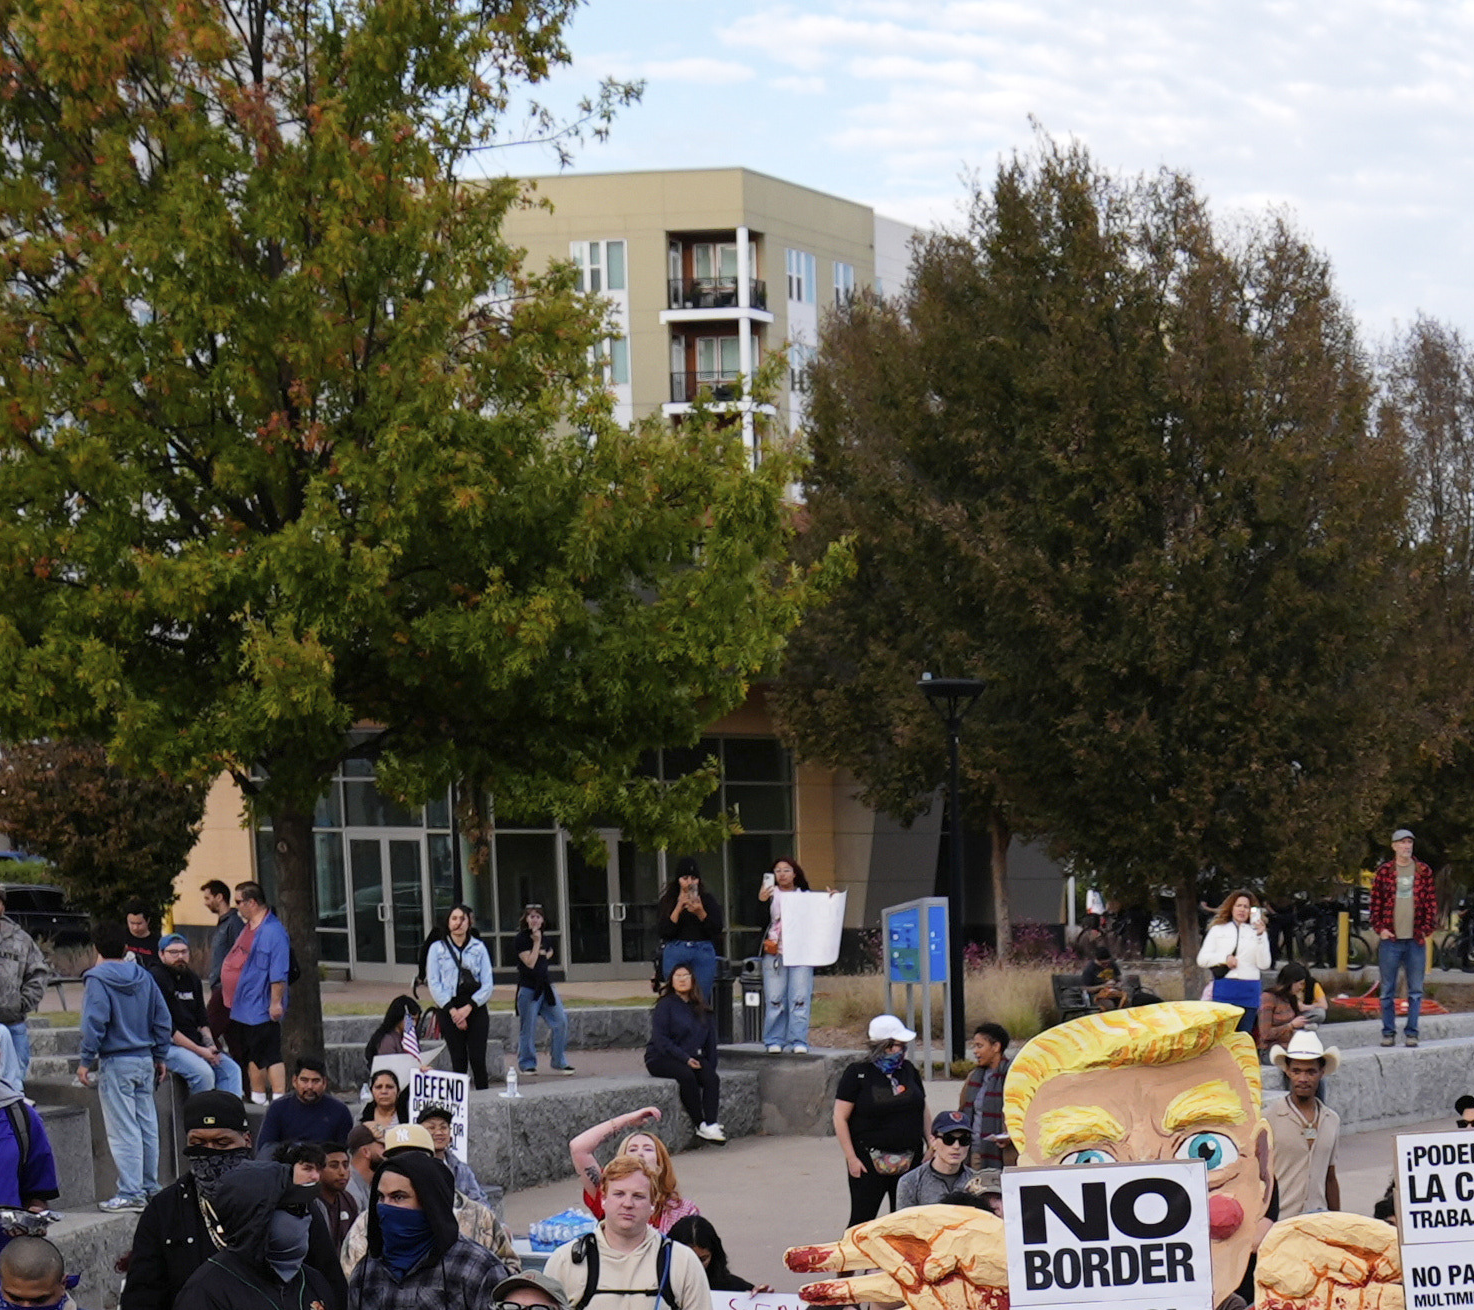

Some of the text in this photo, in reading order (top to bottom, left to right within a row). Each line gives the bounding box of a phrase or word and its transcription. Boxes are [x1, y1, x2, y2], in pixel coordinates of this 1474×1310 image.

[415, 1075, 464, 1102] DEFEND
[1408, 1174, 1447, 1204] LA
[1019, 1178, 1192, 1245] NO
[1024, 1242, 1195, 1291] BORDER
[1412, 1265, 1441, 1288] NO
